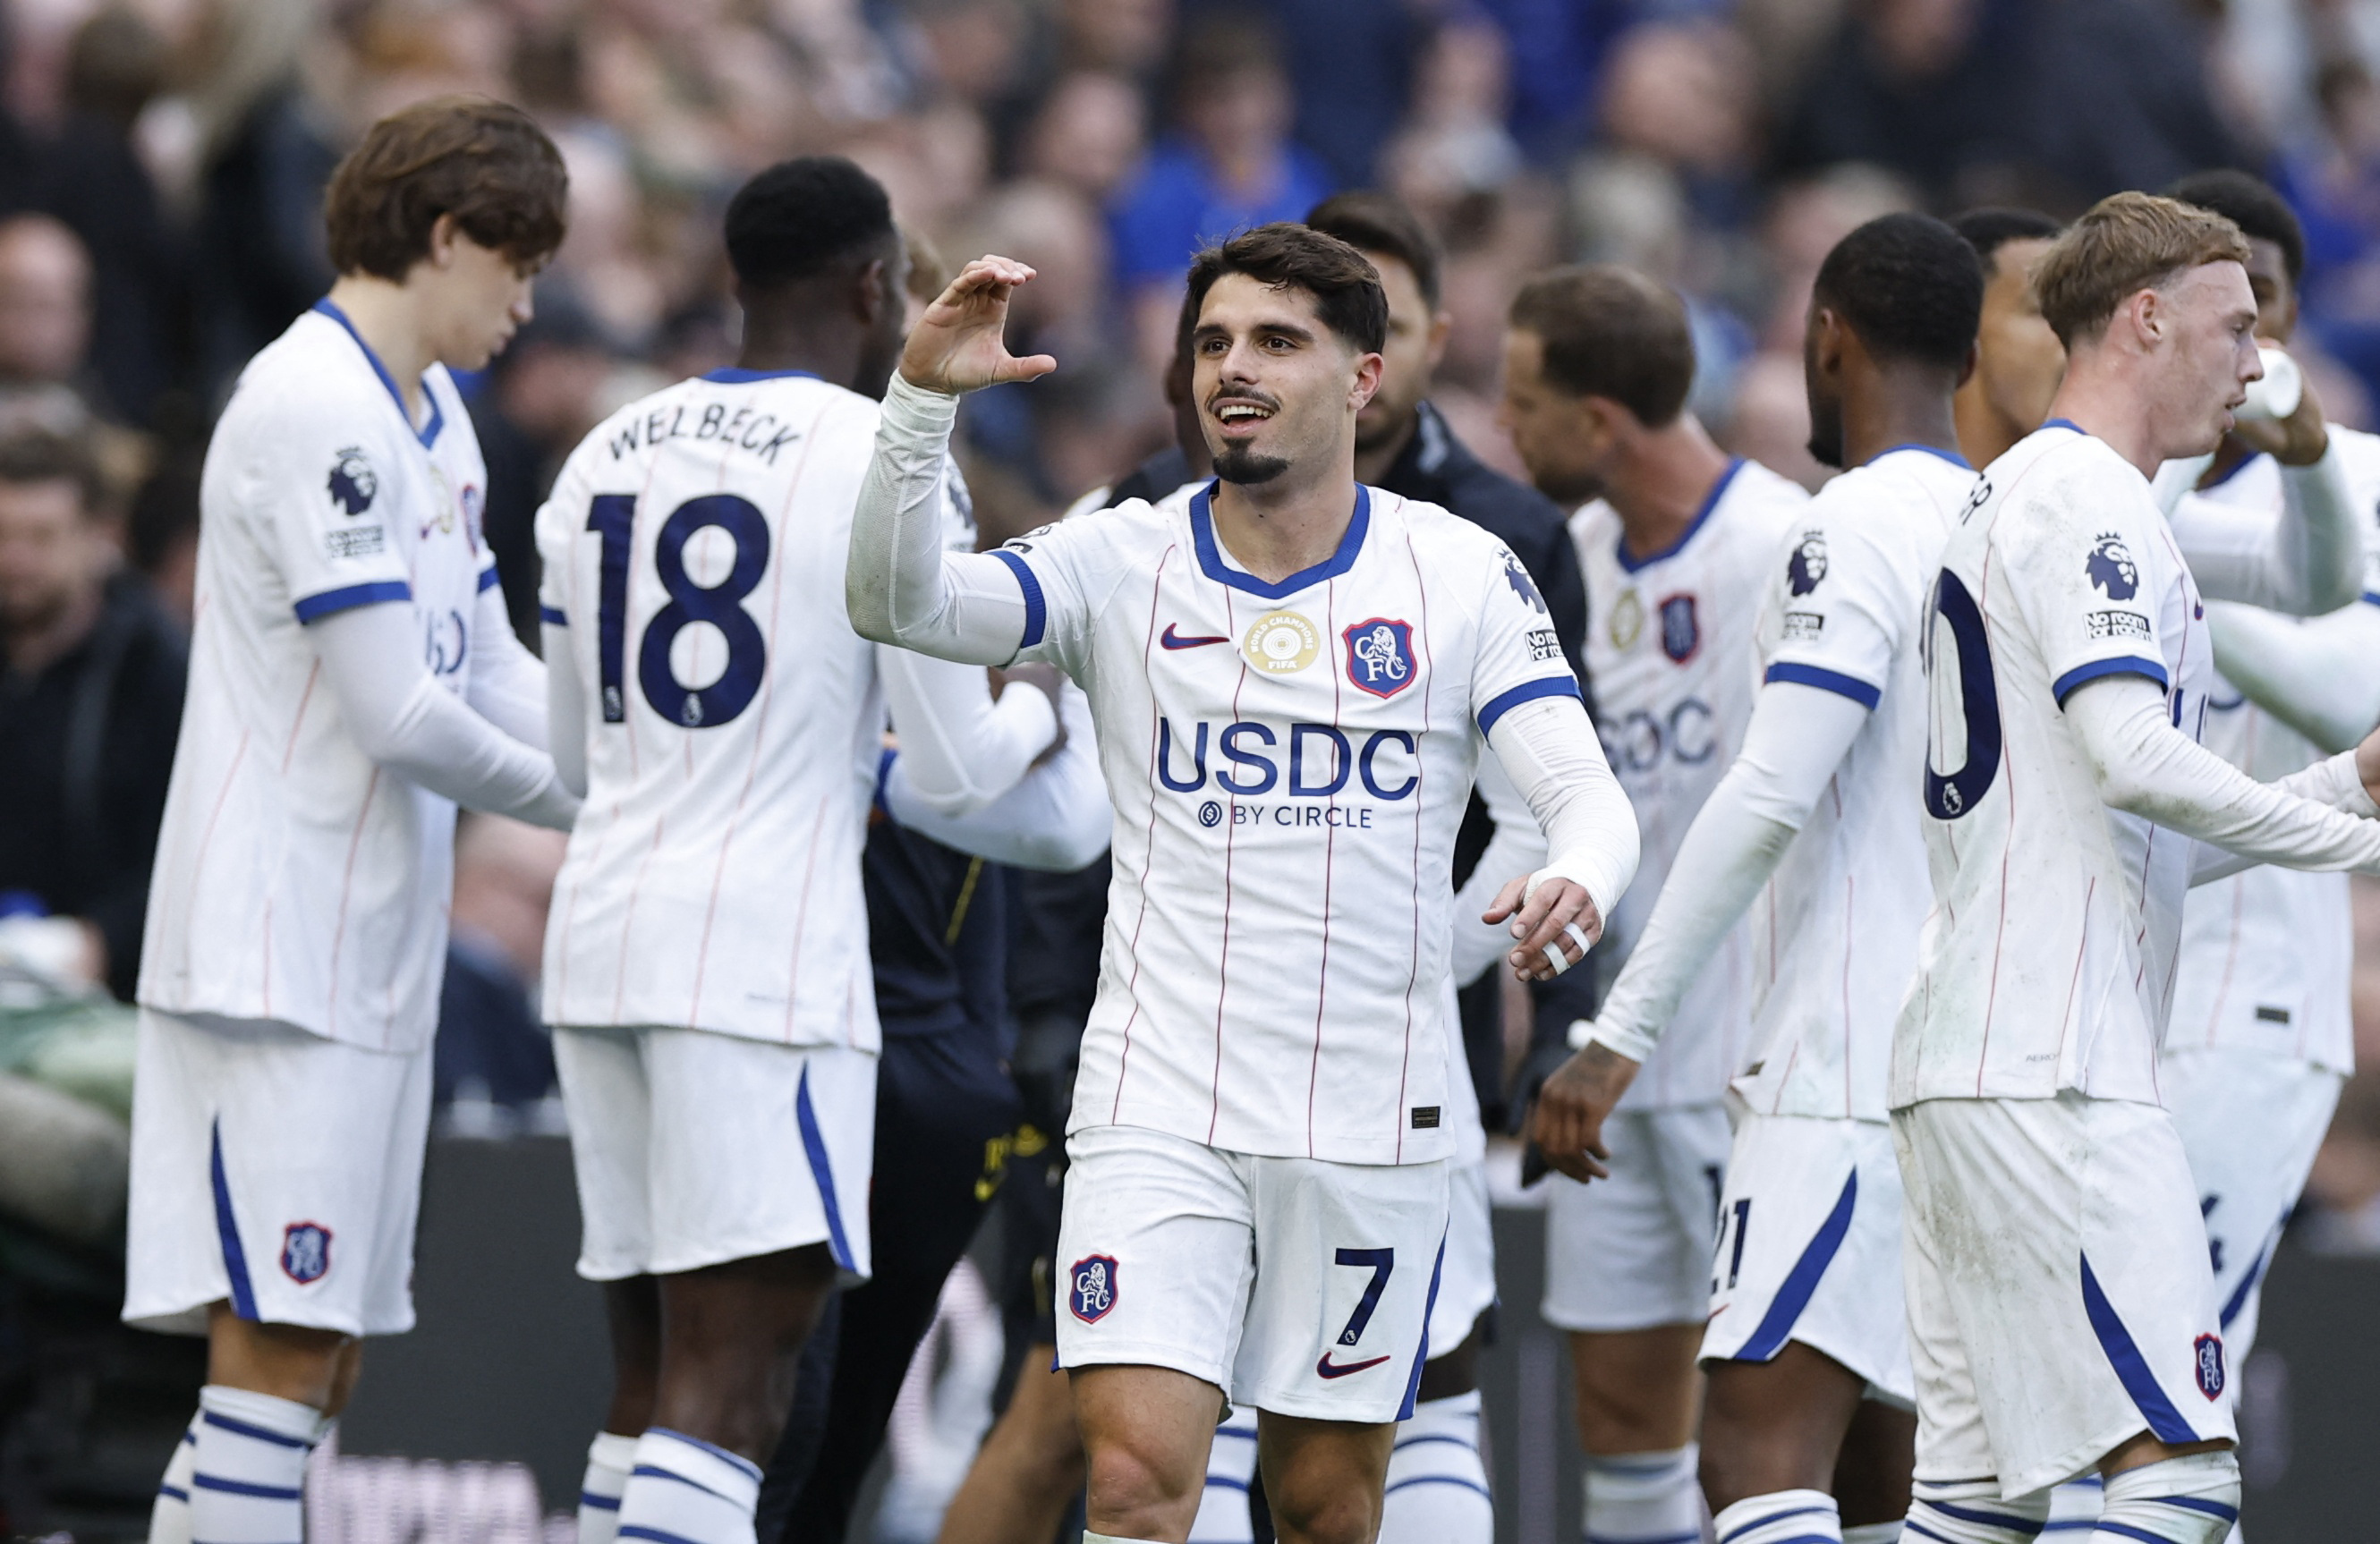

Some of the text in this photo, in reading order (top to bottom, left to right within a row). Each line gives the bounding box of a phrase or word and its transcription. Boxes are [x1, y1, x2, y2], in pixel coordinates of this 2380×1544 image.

[608, 403, 800, 467] WELBECK
[586, 494, 770, 728] 18
[1250, 616, 1313, 653] WORLD CHAMPIONS
[1268, 660, 1297, 670] FIFA
[1158, 716, 1419, 801] USDC
[1233, 805, 1373, 829] BY CIRCLE
[1335, 1247, 1394, 1346] 7
